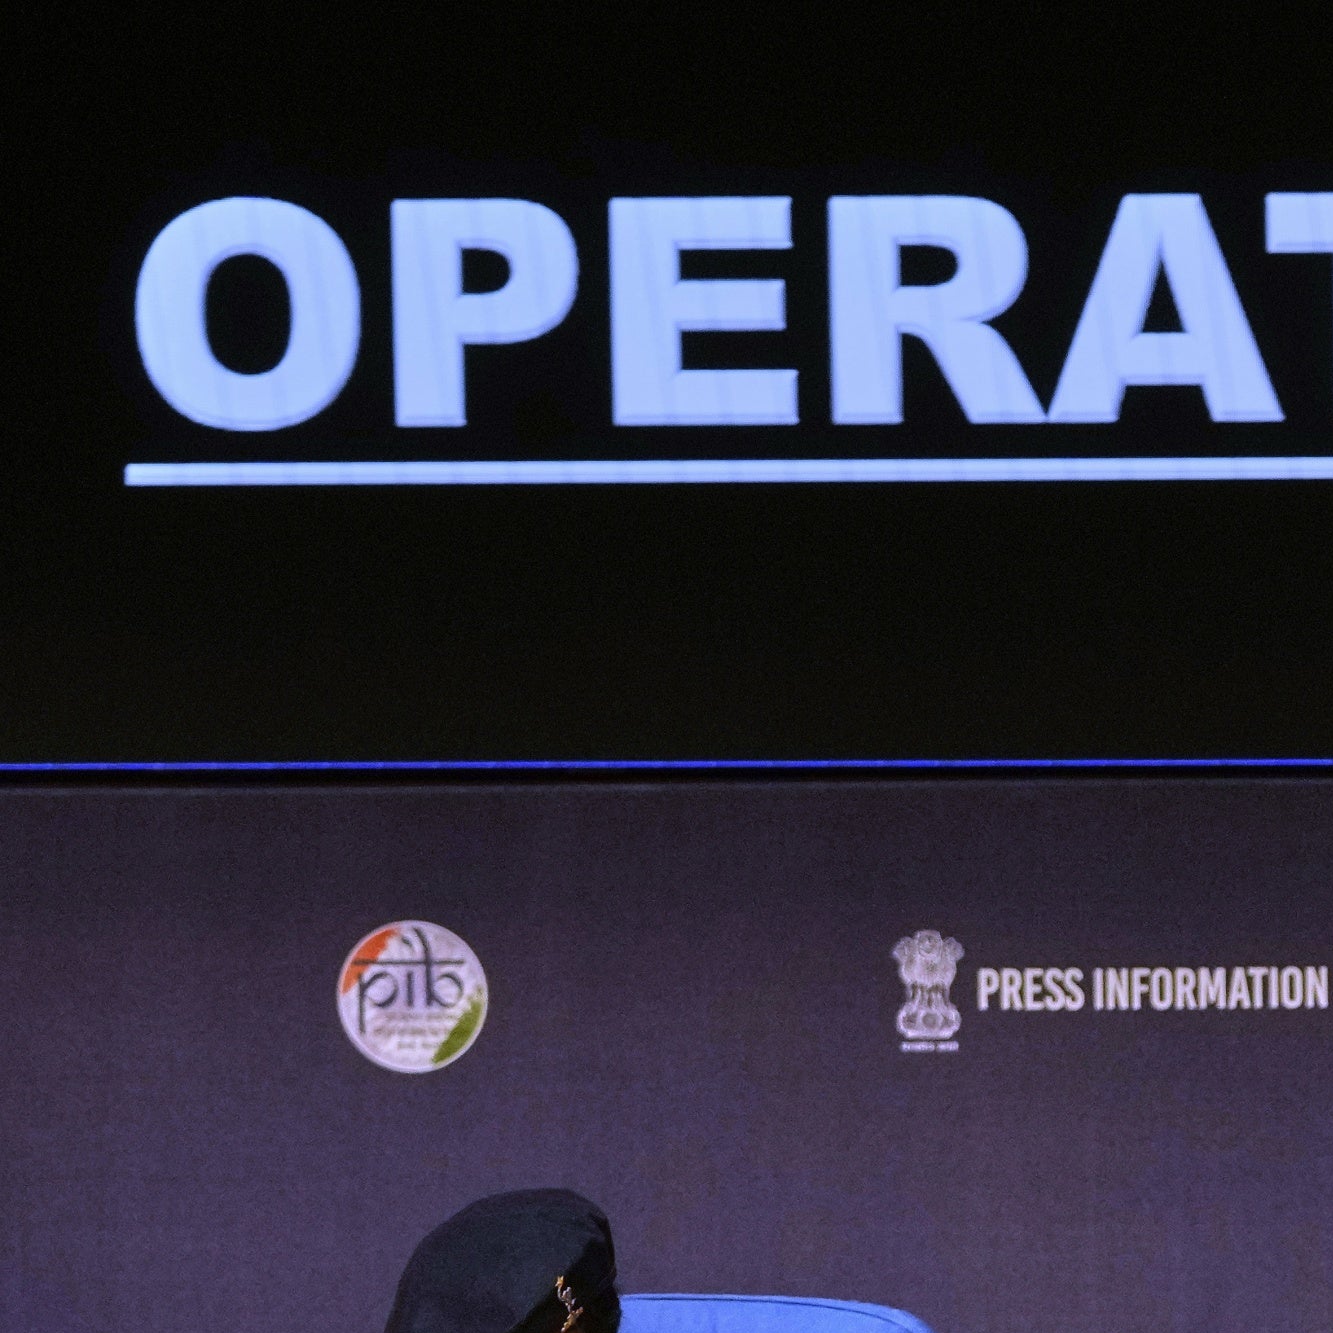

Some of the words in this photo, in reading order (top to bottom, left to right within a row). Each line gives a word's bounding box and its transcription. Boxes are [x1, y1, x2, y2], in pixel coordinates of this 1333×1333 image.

[352, 926, 465, 1034] pib
[977, 967, 1086, 1012] PRESS
[1093, 966, 1330, 1012] INFORMATION
